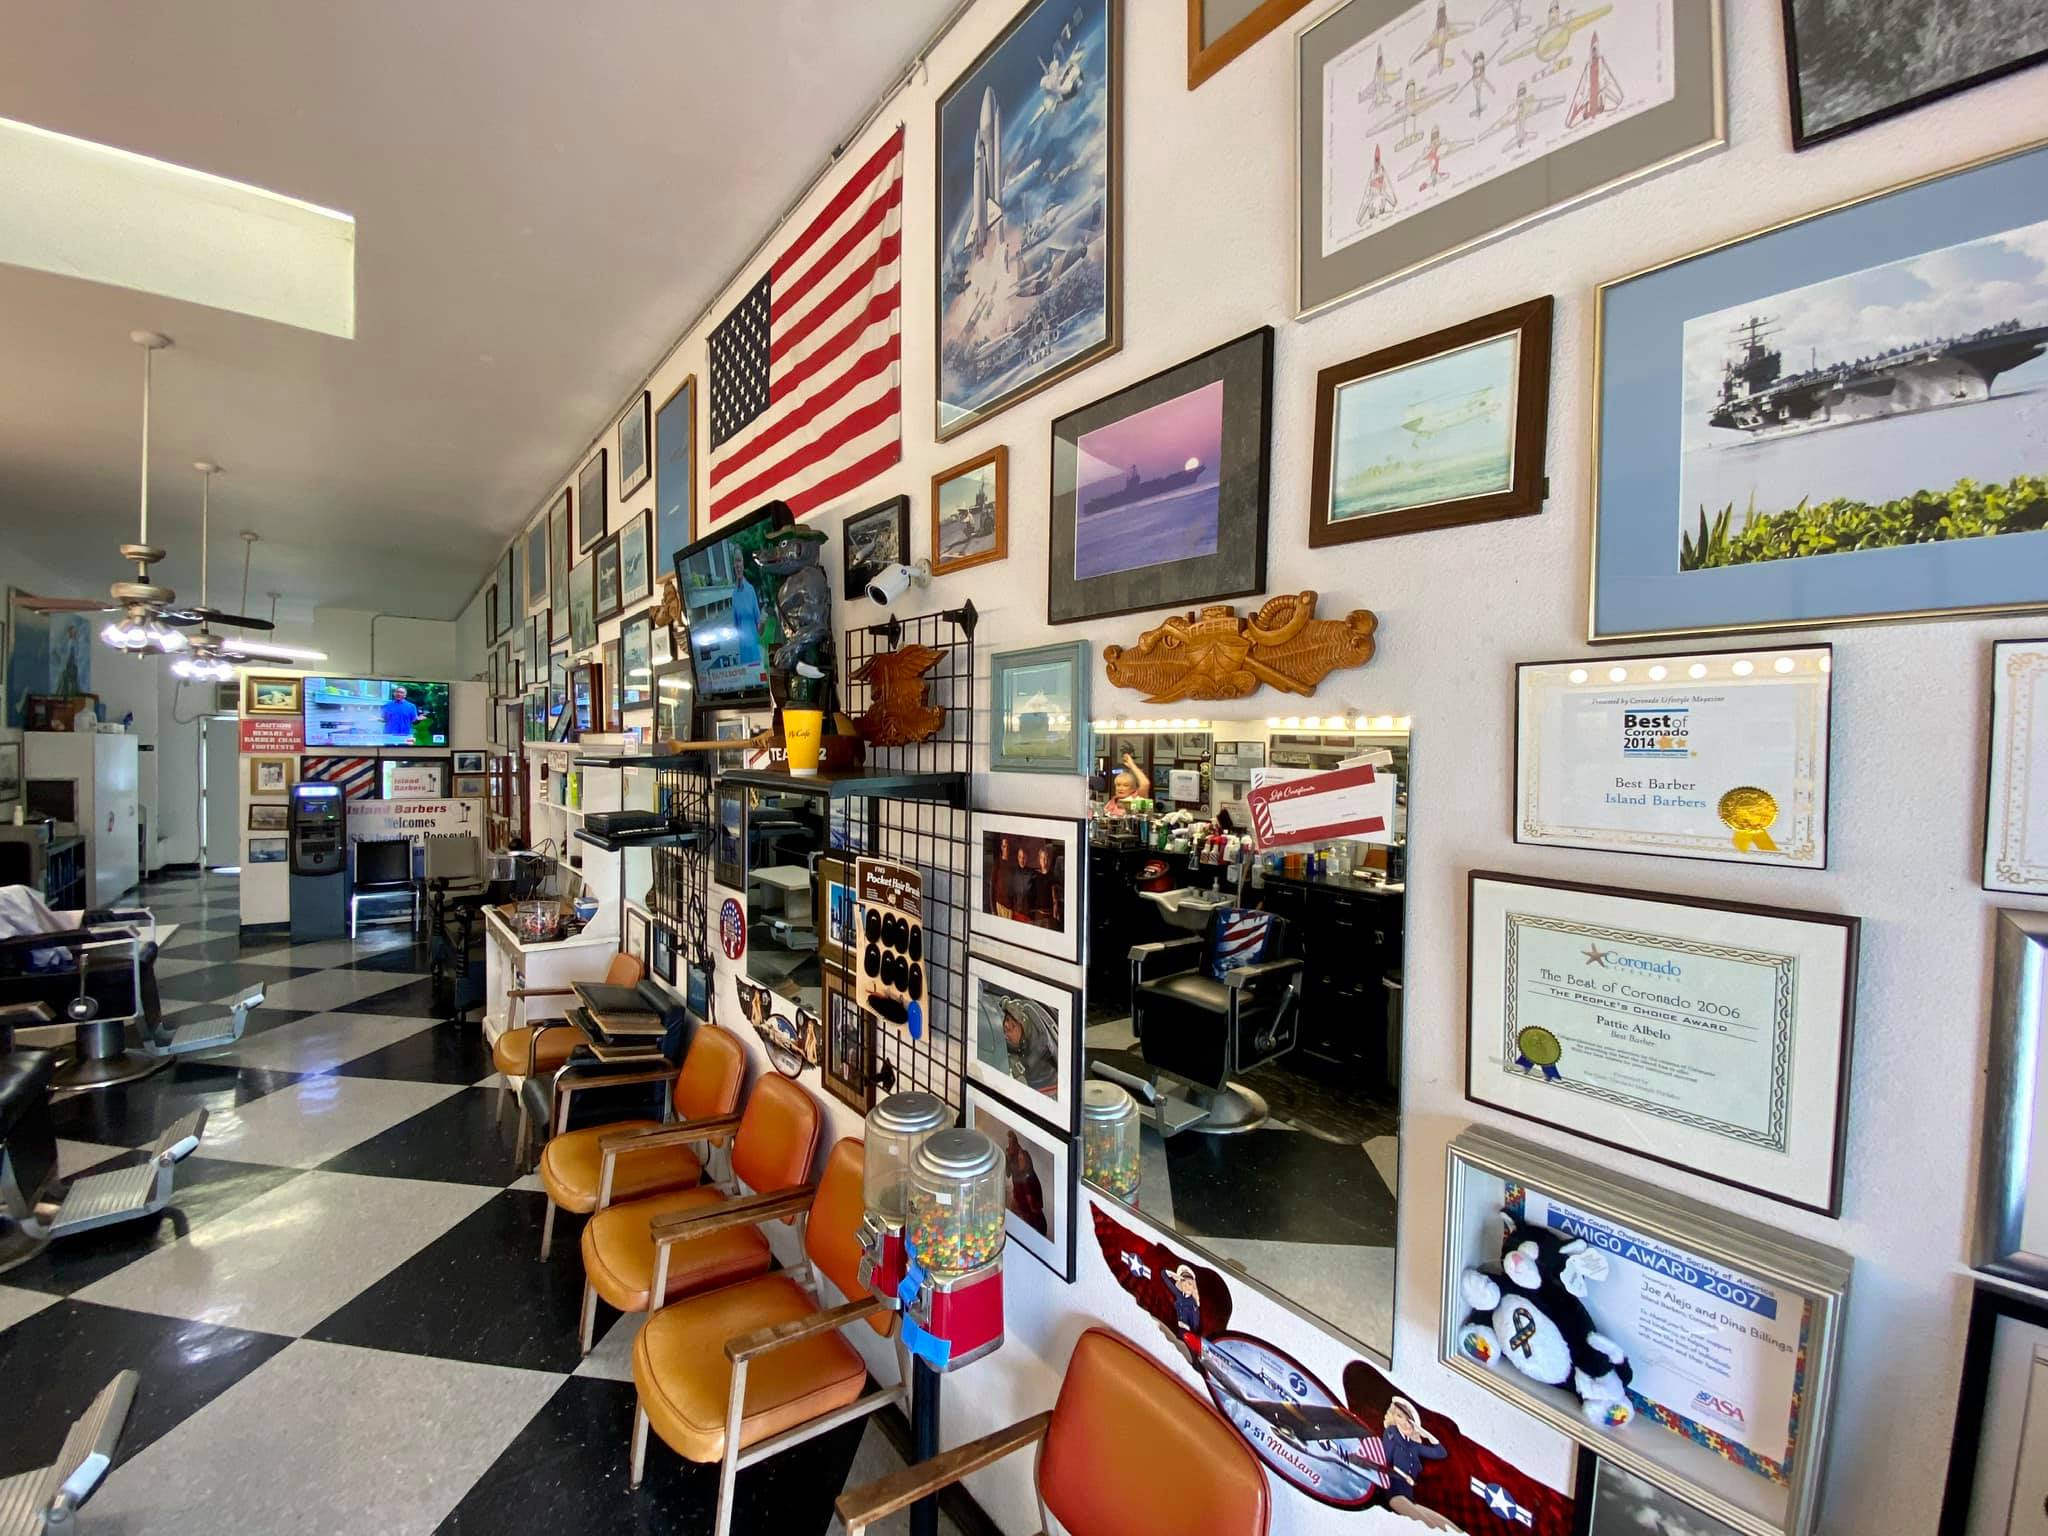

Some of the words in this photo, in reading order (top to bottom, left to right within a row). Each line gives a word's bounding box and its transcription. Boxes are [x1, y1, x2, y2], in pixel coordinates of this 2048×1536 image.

[1660, 697, 1690, 705] Lifestyle
[1691, 695, 1725, 704] Magazine
[1624, 714, 1671, 728] Best
[1671, 715, 1689, 728] of
[1624, 728, 1689, 737] Coronado
[1624, 737, 1656, 749] 2014
[769, 747, 789, 761] TEA
[1615, 777, 1643, 789] Best
[1648, 778, 1697, 791] Barber
[1604, 793, 1646, 805] Island
[1652, 794, 1707, 808] Barbers
[347, 805, 391, 815] Island
[394, 804, 447, 814] Barbers
[384, 816, 437, 828] Welcomes
[866, 871, 892, 887] Pocket
[892, 877, 906, 891] Hair
[1603, 950, 1682, 977] Coronado
[1540, 967, 1562, 983] The
[1566, 973, 1597, 990] Best
[1602, 983, 1617, 994] of
[1620, 985, 1691, 1009] Coronado
[1696, 1000, 1741, 1019] 2006
[1550, 987, 1570, 998] THE
[1574, 992, 1629, 1011] PEOPLE'S
[1633, 1006, 1678, 1021] CHOICE
[1682, 1016, 1728, 1032] AWARD
[1596, 1015, 1630, 1031] Pattie
[1631, 1023, 1671, 1041] Albelo
[1610, 1030, 1626, 1041] Best
[1564, 1208, 1585, 1221] Diego
[1587, 1218, 1614, 1233] County
[1616, 1229, 1651, 1247] Chapter
[1653, 1244, 1683, 1260] Autism
[1686, 1256, 1720, 1275] Society
[1722, 1272, 1733, 1280] of
[1737, 1278, 1775, 1297] America
[1560, 1218, 1623, 1253] AMIGO
[1625, 1244, 1699, 1284] AWARD
[1703, 1274, 1761, 1310] 2007
[1640, 1281, 1662, 1297] Joe
[1663, 1291, 1692, 1312] Alejo
[1695, 1304, 1717, 1320] and
[1720, 1313, 1747, 1334] Dina
[1750, 1327, 1794, 1353] Billings
[1709, 1396, 1745, 1423] ASA
[1243, 1418, 1266, 1442] P-51
[1266, 1436, 1322, 1485] Mustang
